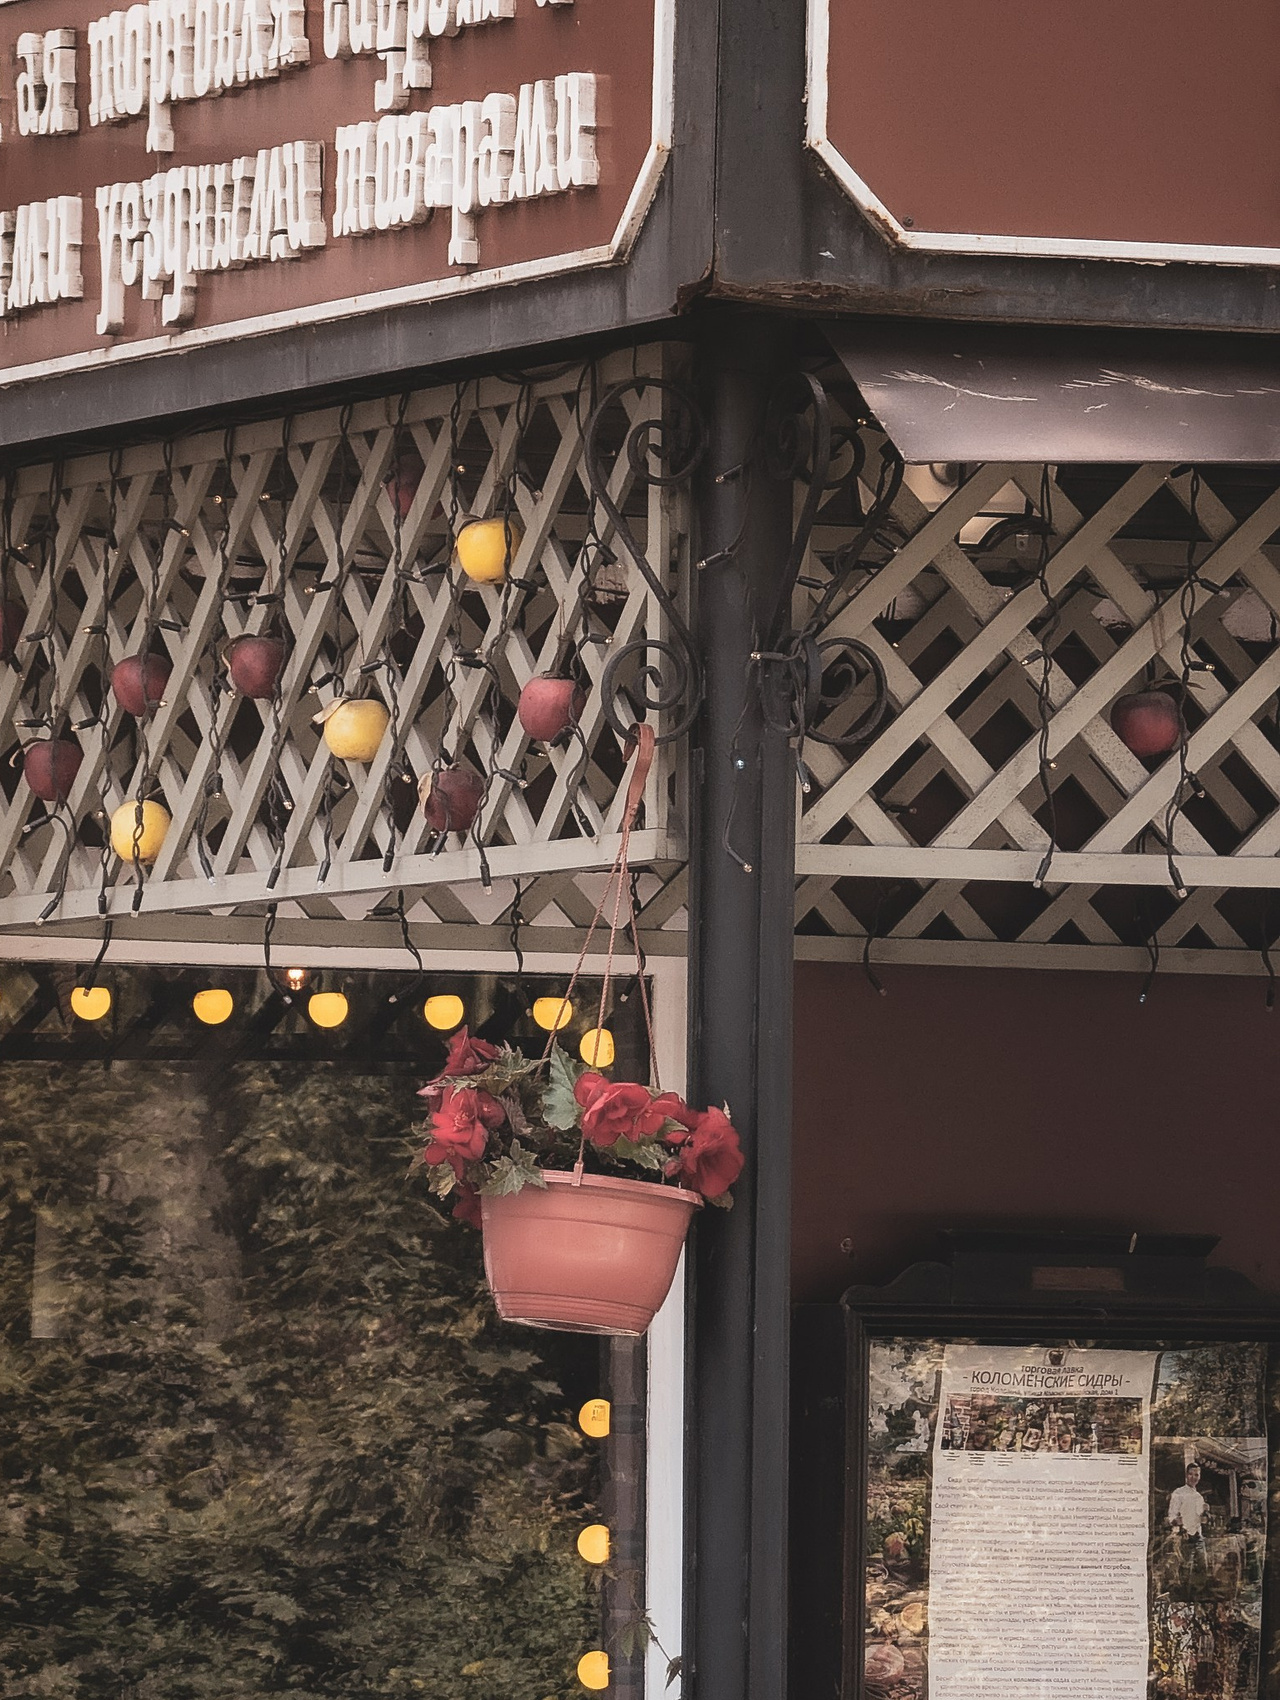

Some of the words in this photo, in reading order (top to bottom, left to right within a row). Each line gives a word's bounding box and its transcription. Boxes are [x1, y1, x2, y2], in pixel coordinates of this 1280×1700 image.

[96, 140, 328, 335] уездными
[333, 71, 600, 266] товарами
[1021, 1365, 1061, 1374] торговая
[972, 1371, 1075, 1388] КОЛОМЕНСКИЕ
[1078, 1374, 1123, 1389] СИДРЫ
